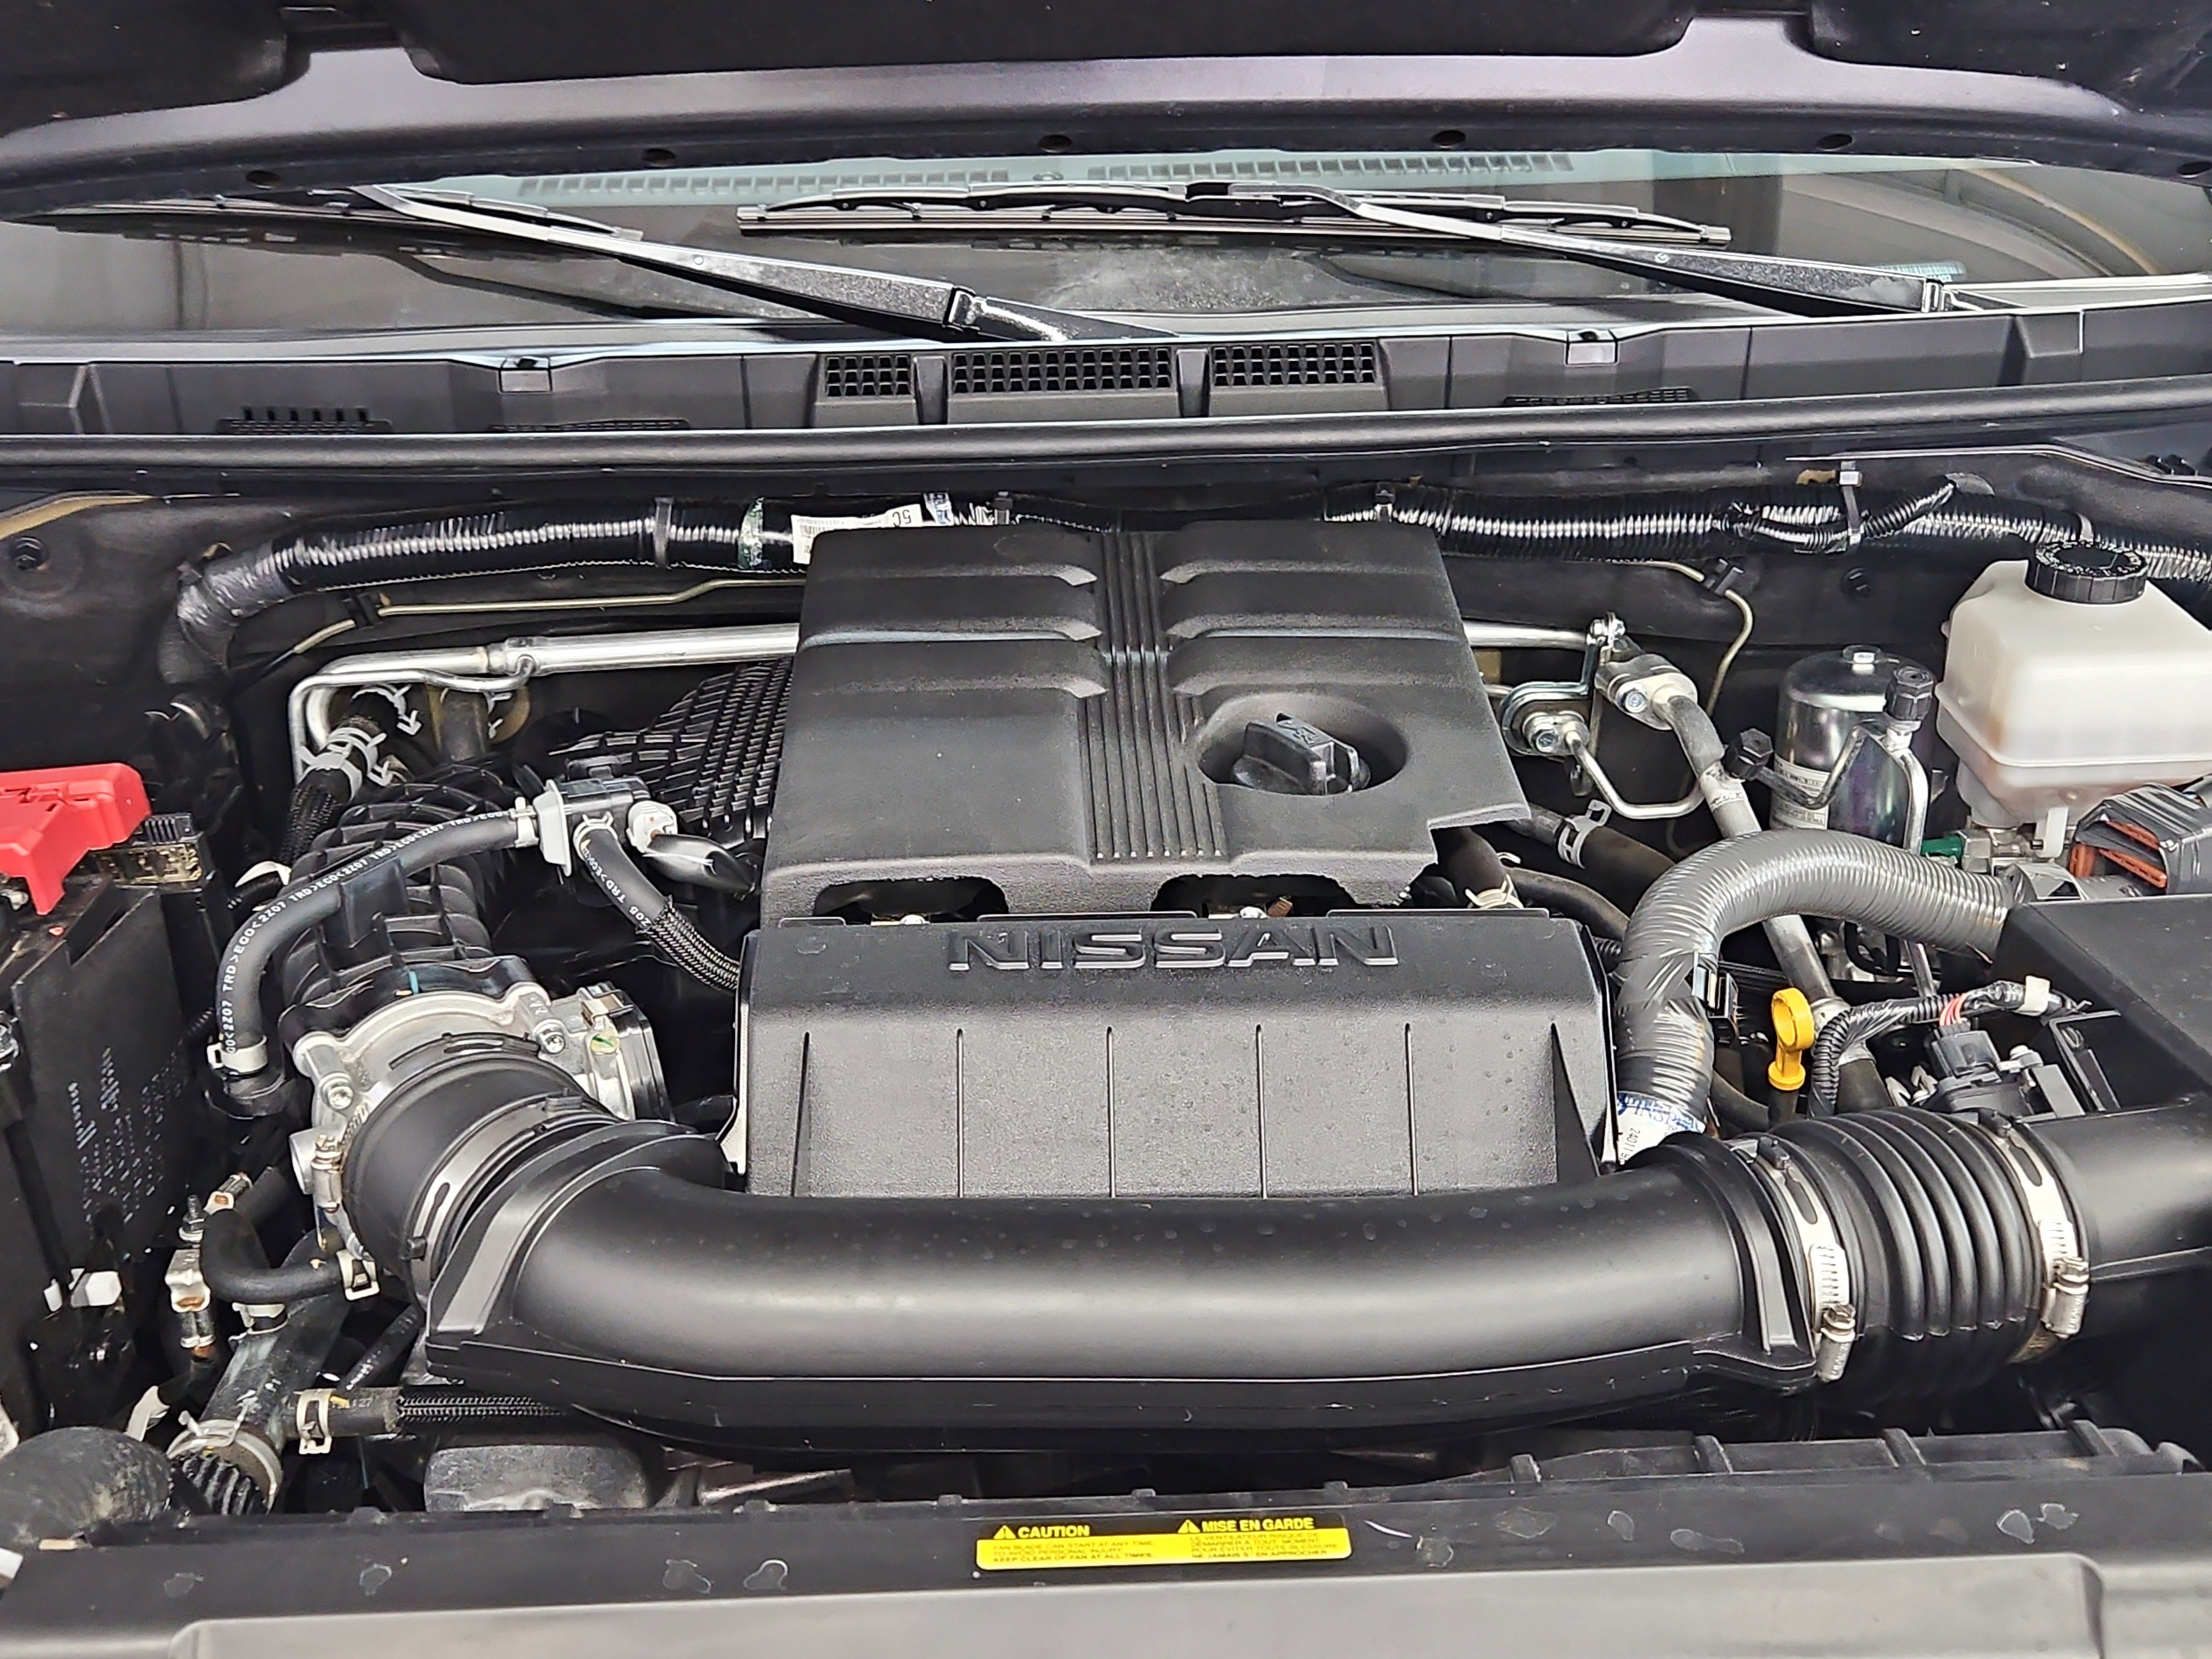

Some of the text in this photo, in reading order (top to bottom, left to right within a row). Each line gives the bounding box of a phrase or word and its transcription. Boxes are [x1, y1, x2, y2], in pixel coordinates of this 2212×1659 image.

[948, 925, 1399, 971] NISSAN
[1018, 1525, 1090, 1539] CAUTION
[1201, 1517, 1315, 1532] MISE EN GARDE
